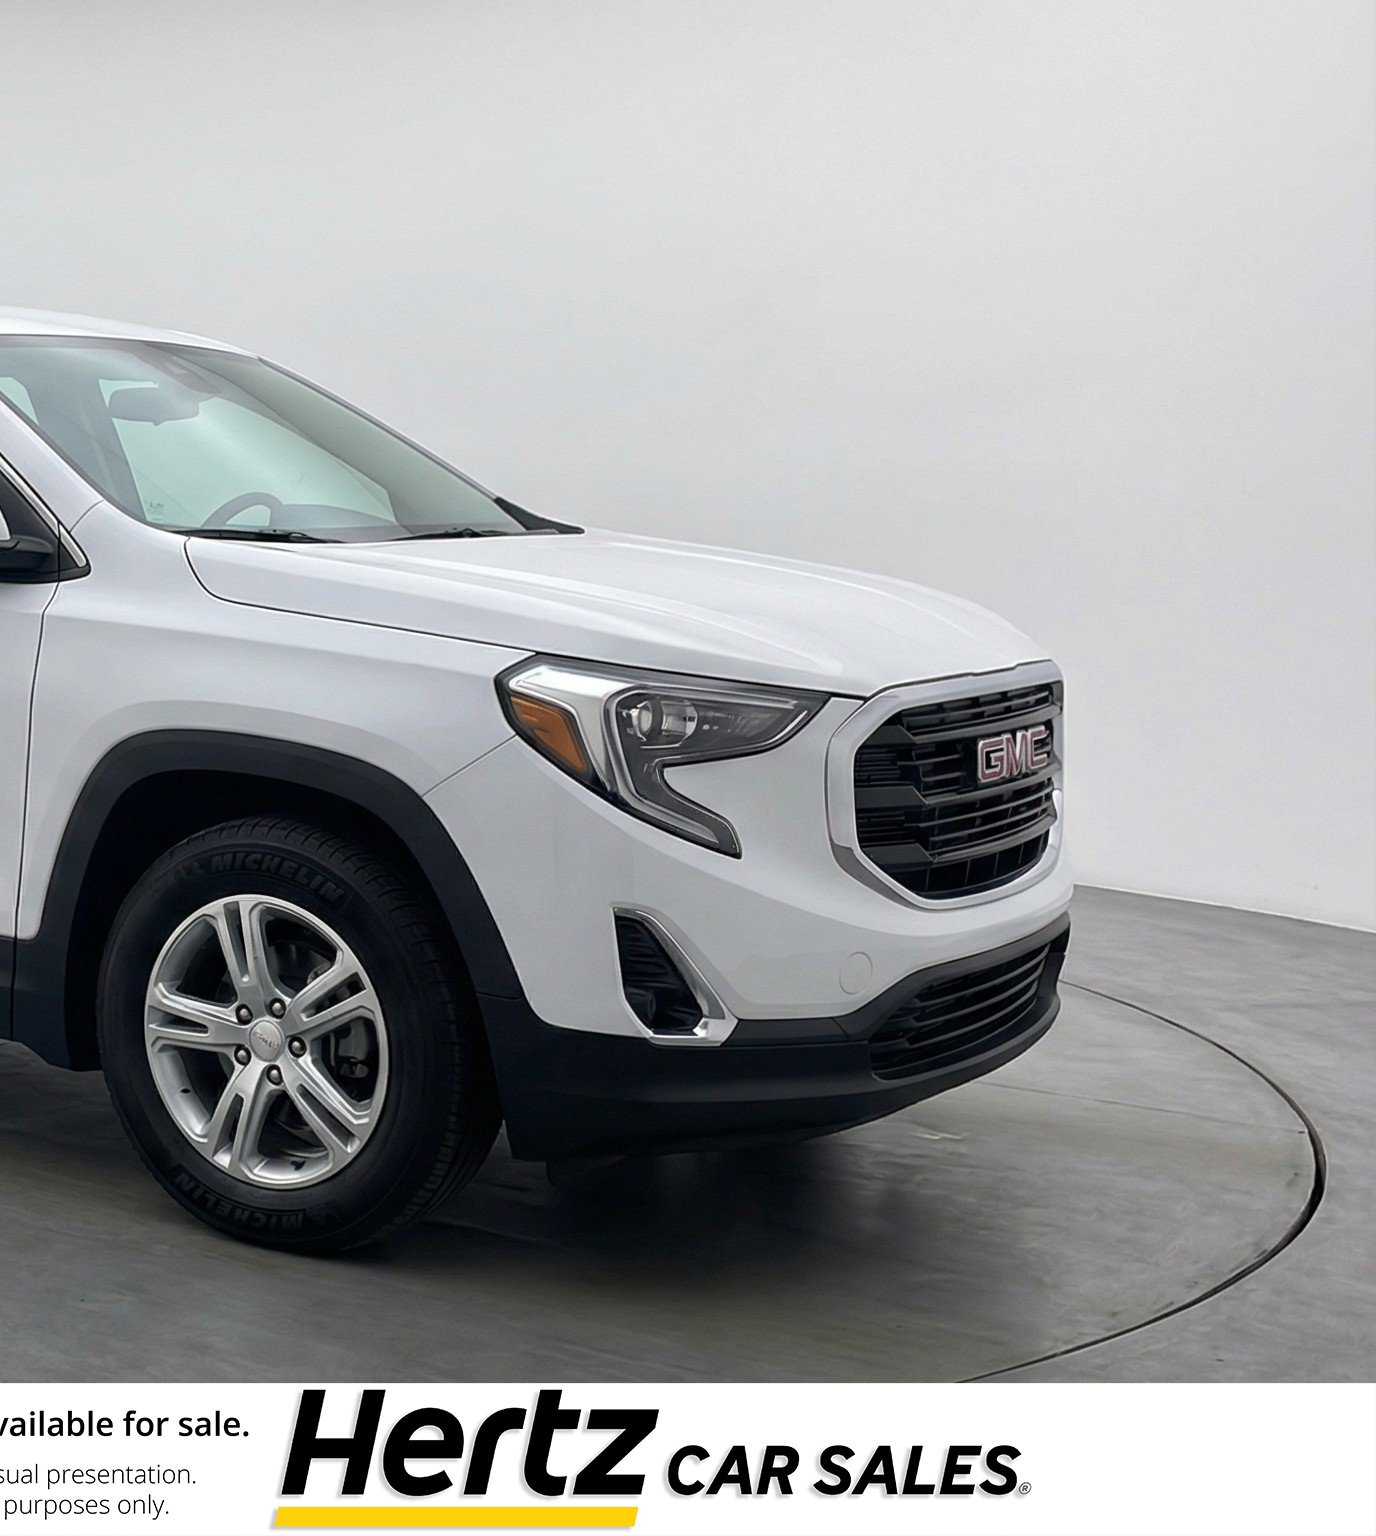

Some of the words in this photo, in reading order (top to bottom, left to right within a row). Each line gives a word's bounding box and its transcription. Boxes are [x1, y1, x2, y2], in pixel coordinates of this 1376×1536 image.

[977, 725, 1047, 783] GMC
[210, 851, 347, 903] MICHELIN
[174, 1171, 305, 1231] MICHELIN
